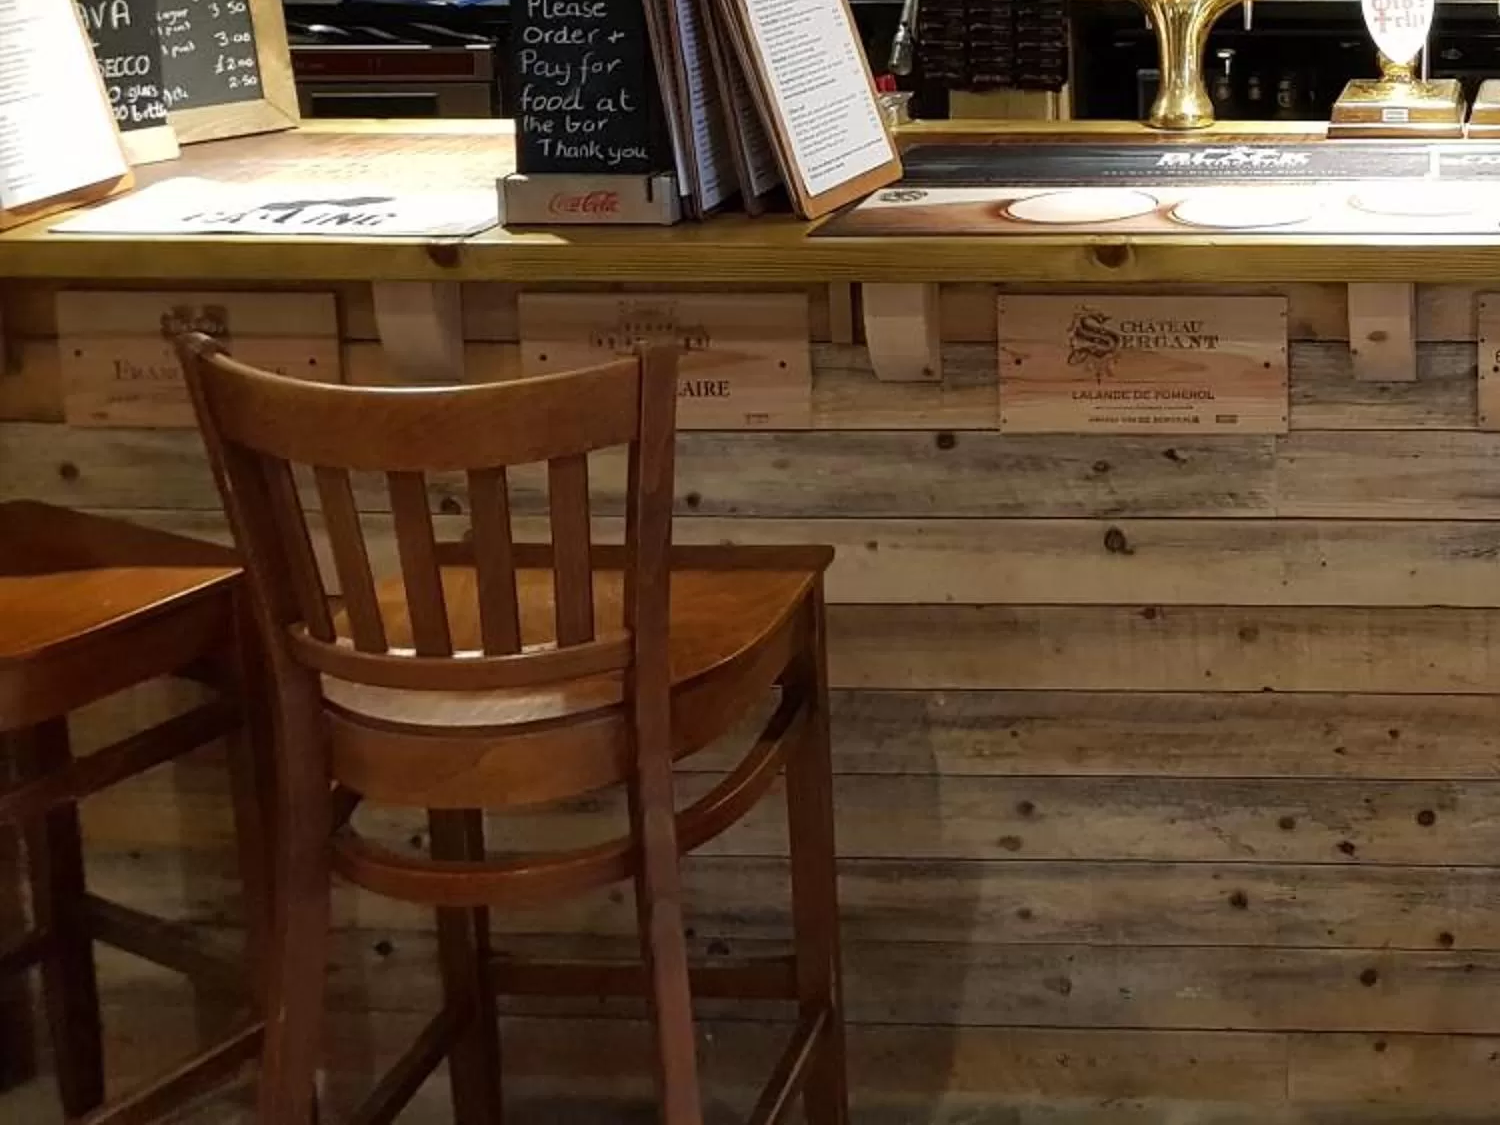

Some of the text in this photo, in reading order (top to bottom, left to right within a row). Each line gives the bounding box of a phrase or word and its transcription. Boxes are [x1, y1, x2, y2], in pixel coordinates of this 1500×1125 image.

[522, 26, 600, 45] Order
[518, 48, 623, 86] Pay for
[519, 82, 637, 112] food at
[522, 115, 610, 133] the bar
[536, 138, 649, 166] Thank you
[678, 379, 731, 397] AIRE
